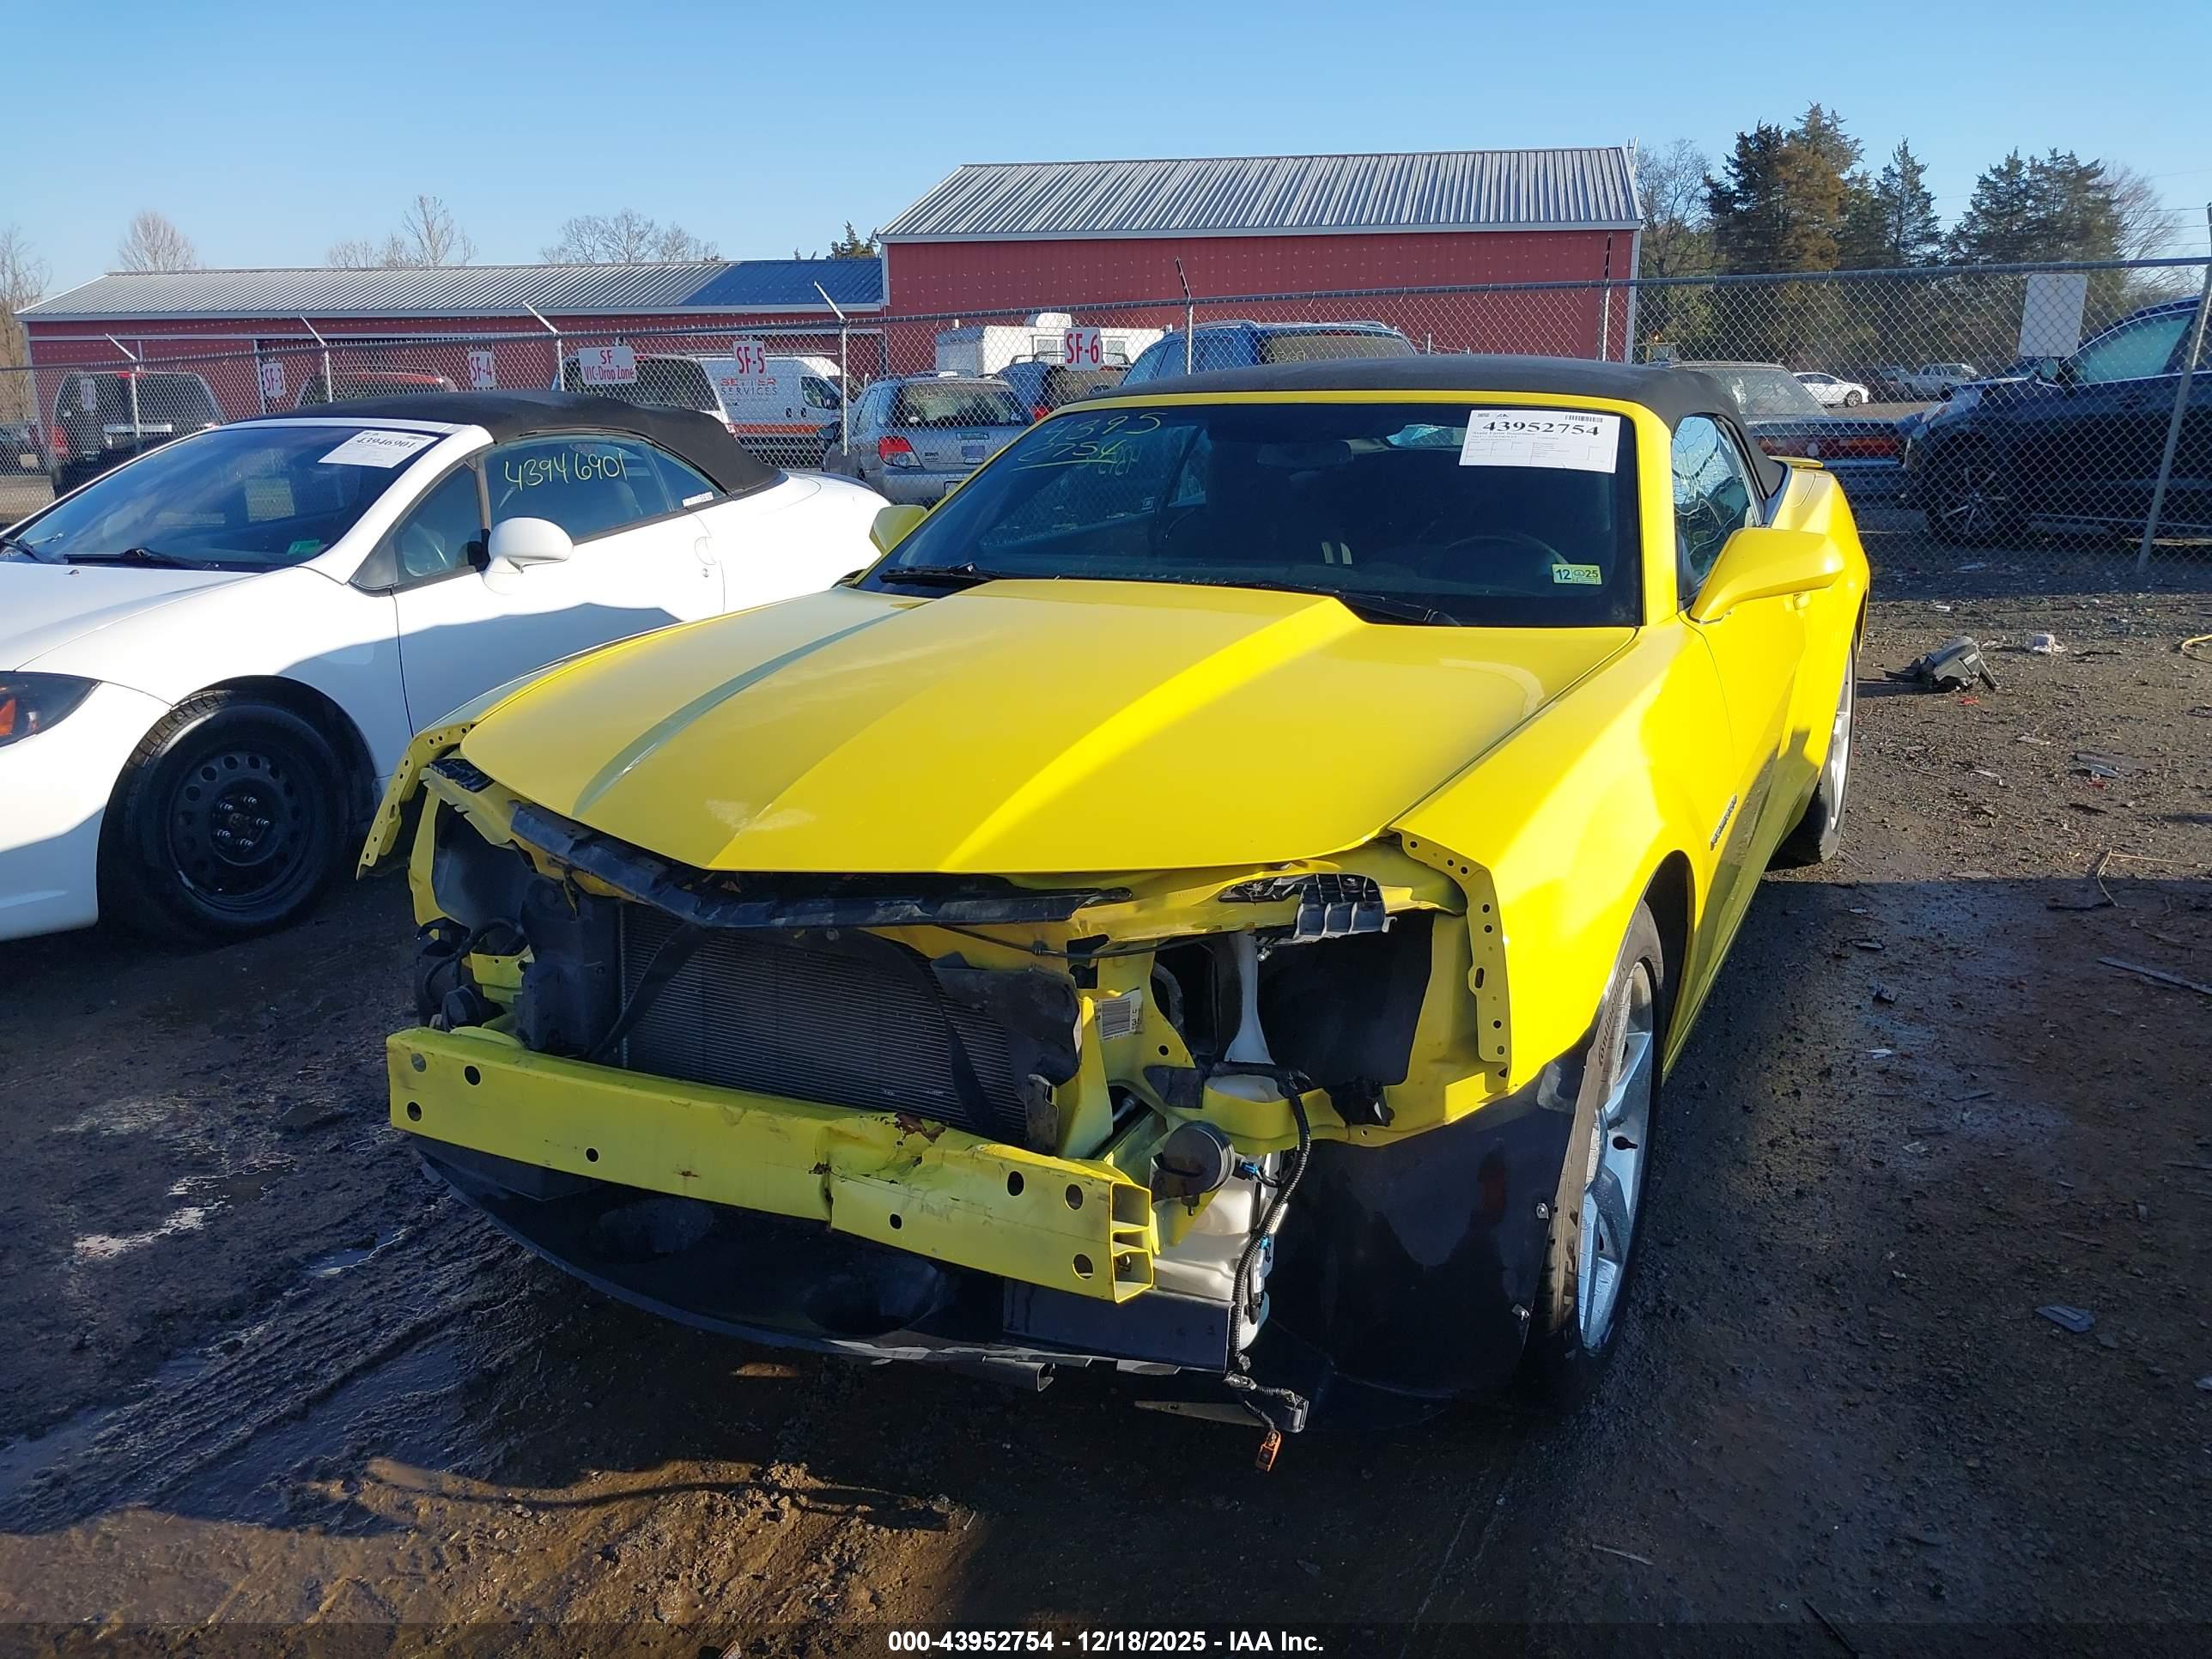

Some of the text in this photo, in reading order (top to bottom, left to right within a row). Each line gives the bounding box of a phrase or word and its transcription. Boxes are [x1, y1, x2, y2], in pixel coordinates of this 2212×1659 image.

[599, 349, 613, 365] SF
[1066, 332, 1099, 364] SF-6
[470, 356, 492, 382] SF-4
[736, 346, 765, 374] SF-5
[264, 368, 284, 392] SF-3
[584, 365, 635, 381] VIC-Drop Zone
[720, 386, 778, 396] SERVICES
[1045, 412, 1169, 443] 4395
[1483, 421, 1600, 436] 43952754
[356, 437, 417, 448] 43946901
[1017, 439, 1127, 462] 2754
[1555, 568, 1599, 580] 12 25
